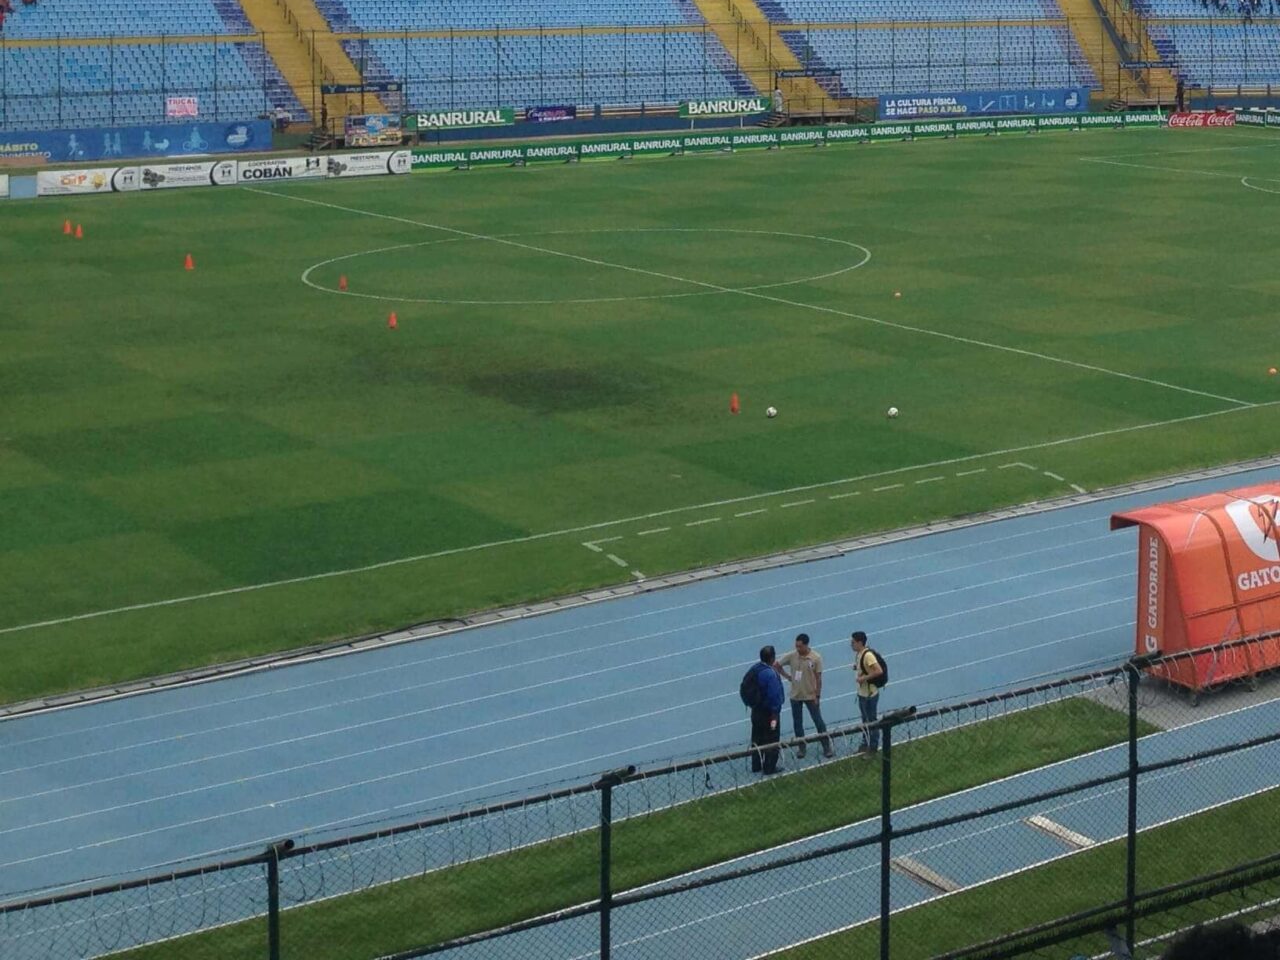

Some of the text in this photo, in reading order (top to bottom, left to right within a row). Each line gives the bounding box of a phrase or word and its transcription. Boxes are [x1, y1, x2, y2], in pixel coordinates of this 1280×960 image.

[688, 99, 766, 114] BANRURAL
[897, 98, 932, 107] CULTURA
[933, 96, 957, 105] FÍSICA
[886, 108, 896, 116] SE
[897, 107, 918, 115] HACE
[918, 106, 939, 114] PASO
[947, 105, 968, 113] PASO
[417, 110, 506, 127] BANRURAL
[411, 113, 1168, 164] BANRURAL BANRURAL BANRURAL BANRURAL BANRURAL BANRURAL BANRURAL BANRURAL BANRURAL BANRURAL BANRURAL BANRURAL BANRURAL BANRURAL BANRURAL BANRURAL
[243, 165, 293, 179] COBÁN
[1145, 537, 1159, 654] G GATORADE
